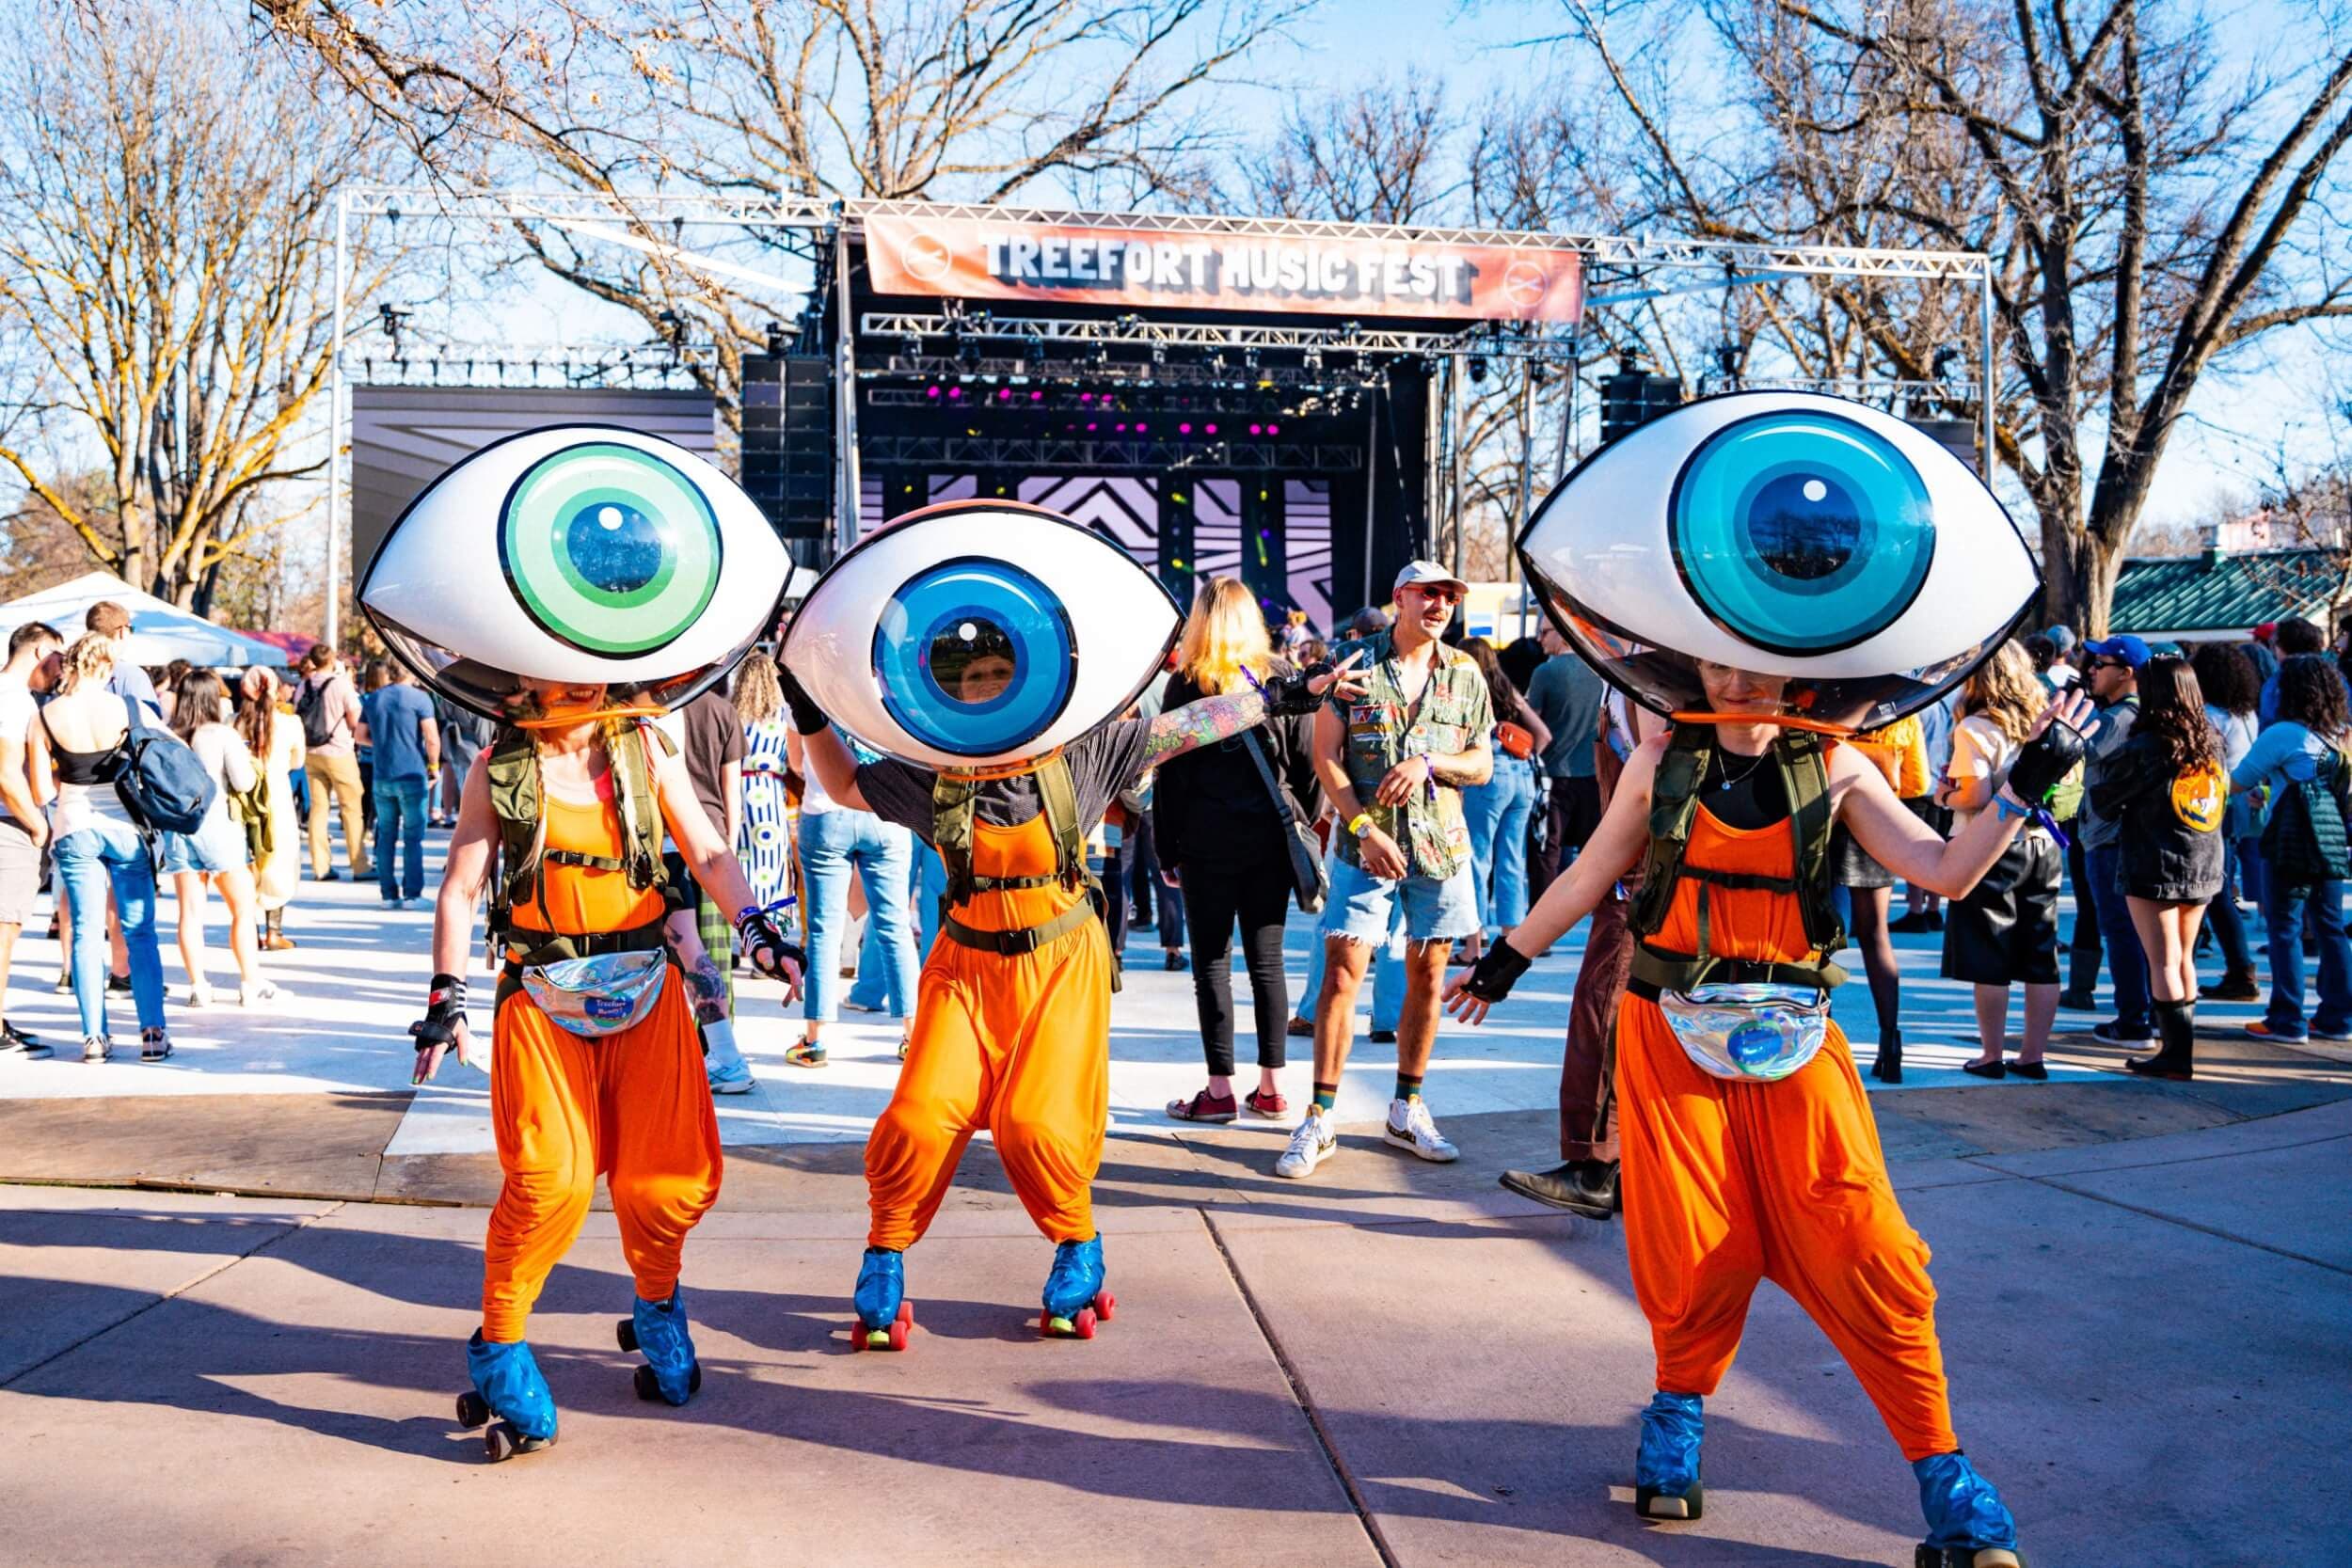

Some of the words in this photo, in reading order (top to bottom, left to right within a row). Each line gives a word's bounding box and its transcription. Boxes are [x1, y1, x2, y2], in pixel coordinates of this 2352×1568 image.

[978, 234, 1214, 288] TREEFORT
[1222, 246, 1349, 293] MUSIC
[1358, 255, 1466, 298] FEST
